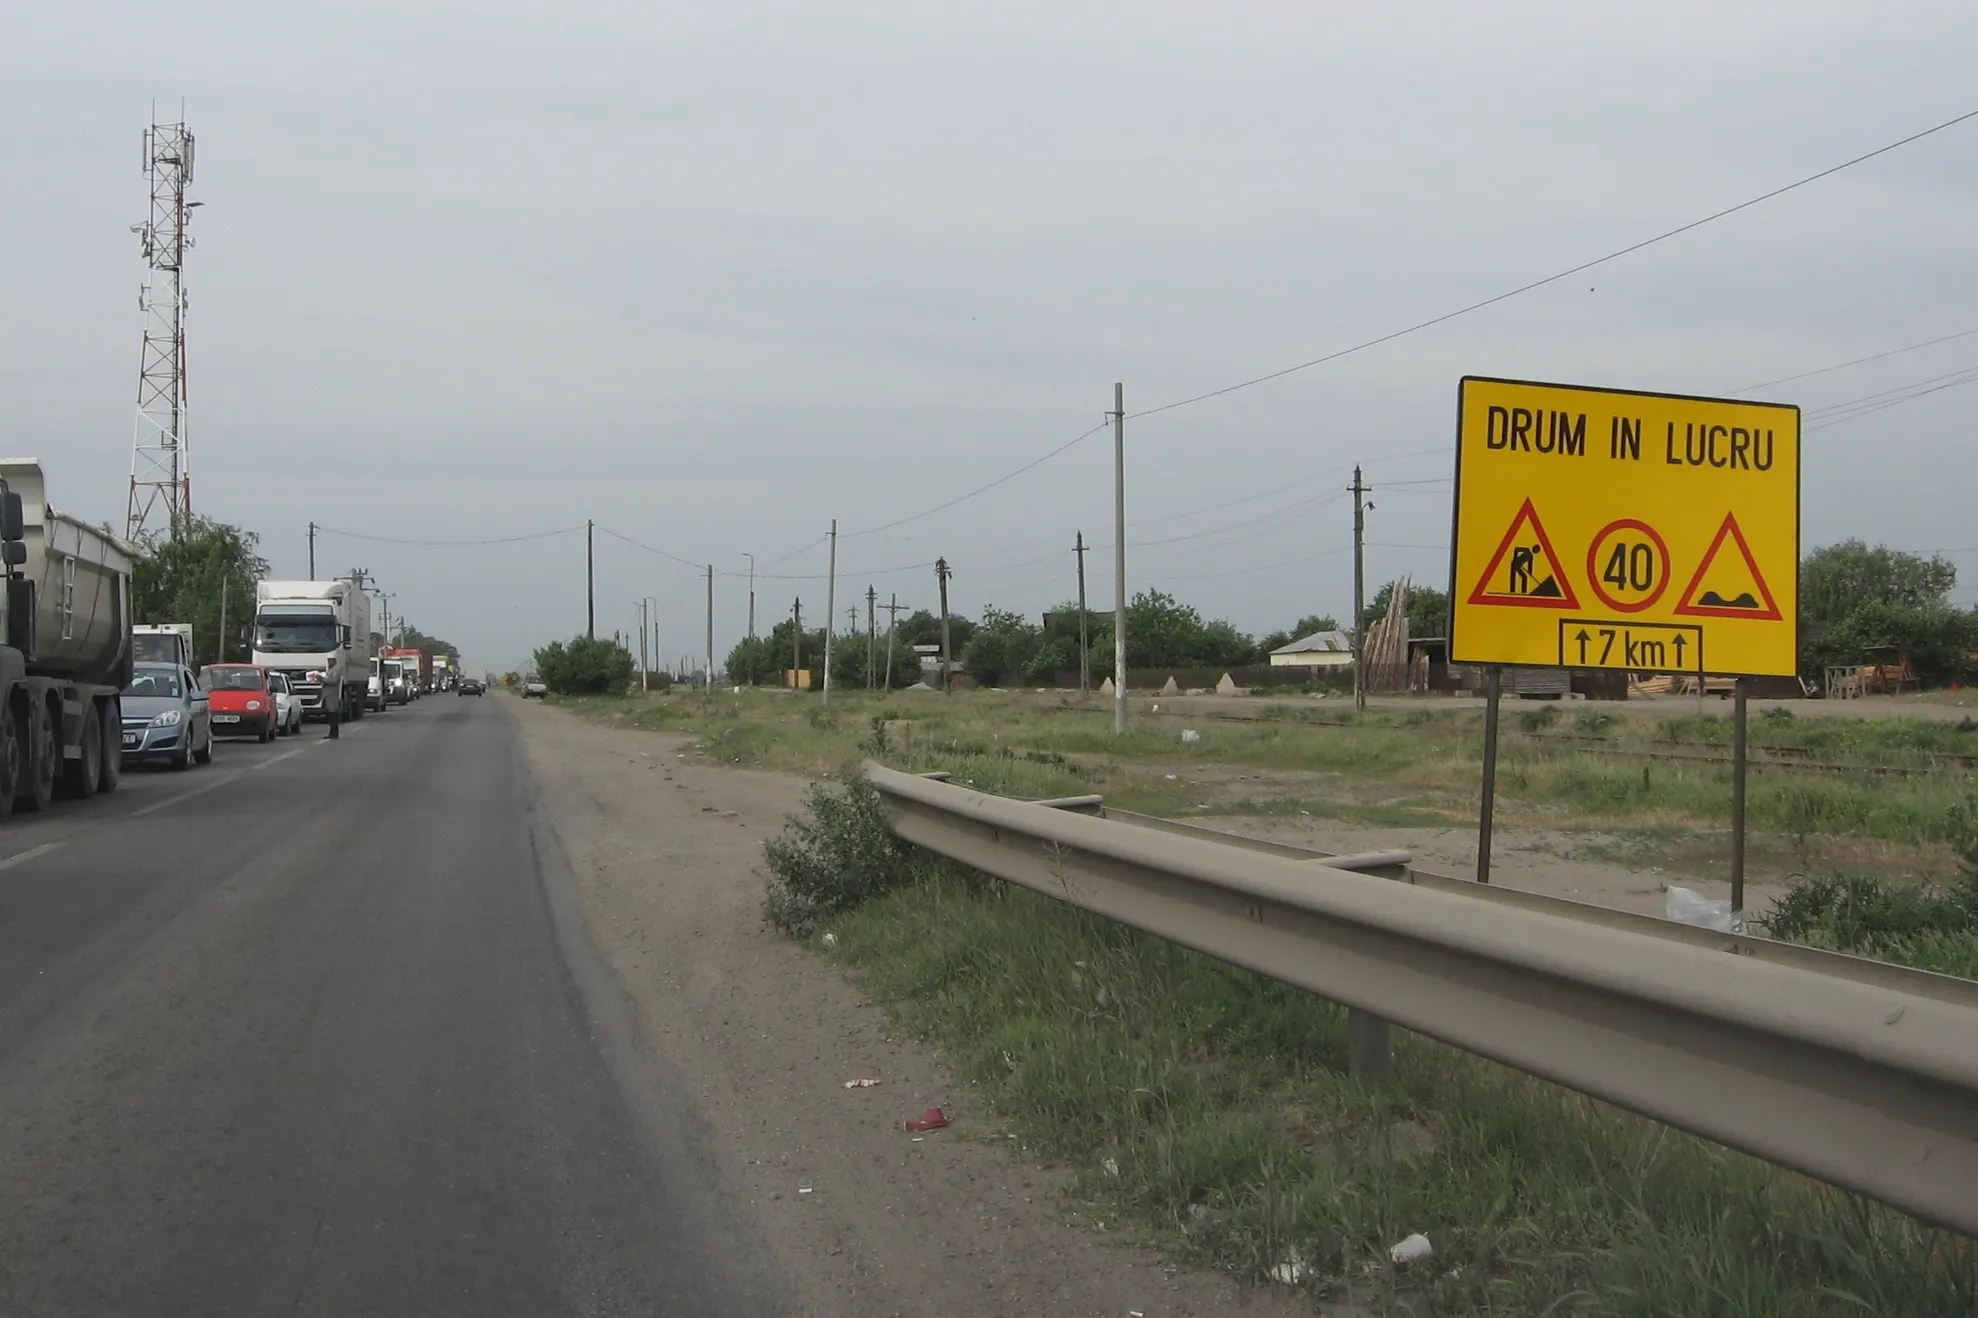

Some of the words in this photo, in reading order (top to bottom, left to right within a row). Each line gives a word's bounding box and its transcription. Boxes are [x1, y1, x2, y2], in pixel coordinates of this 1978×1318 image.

[1487, 406, 1587, 456] DRUM
[1611, 416, 1642, 460] IN
[1667, 422, 1774, 471] LUCRU
[1604, 543, 1653, 591] 40
[1599, 629, 1616, 665] 7
[1625, 631, 1665, 666] km
